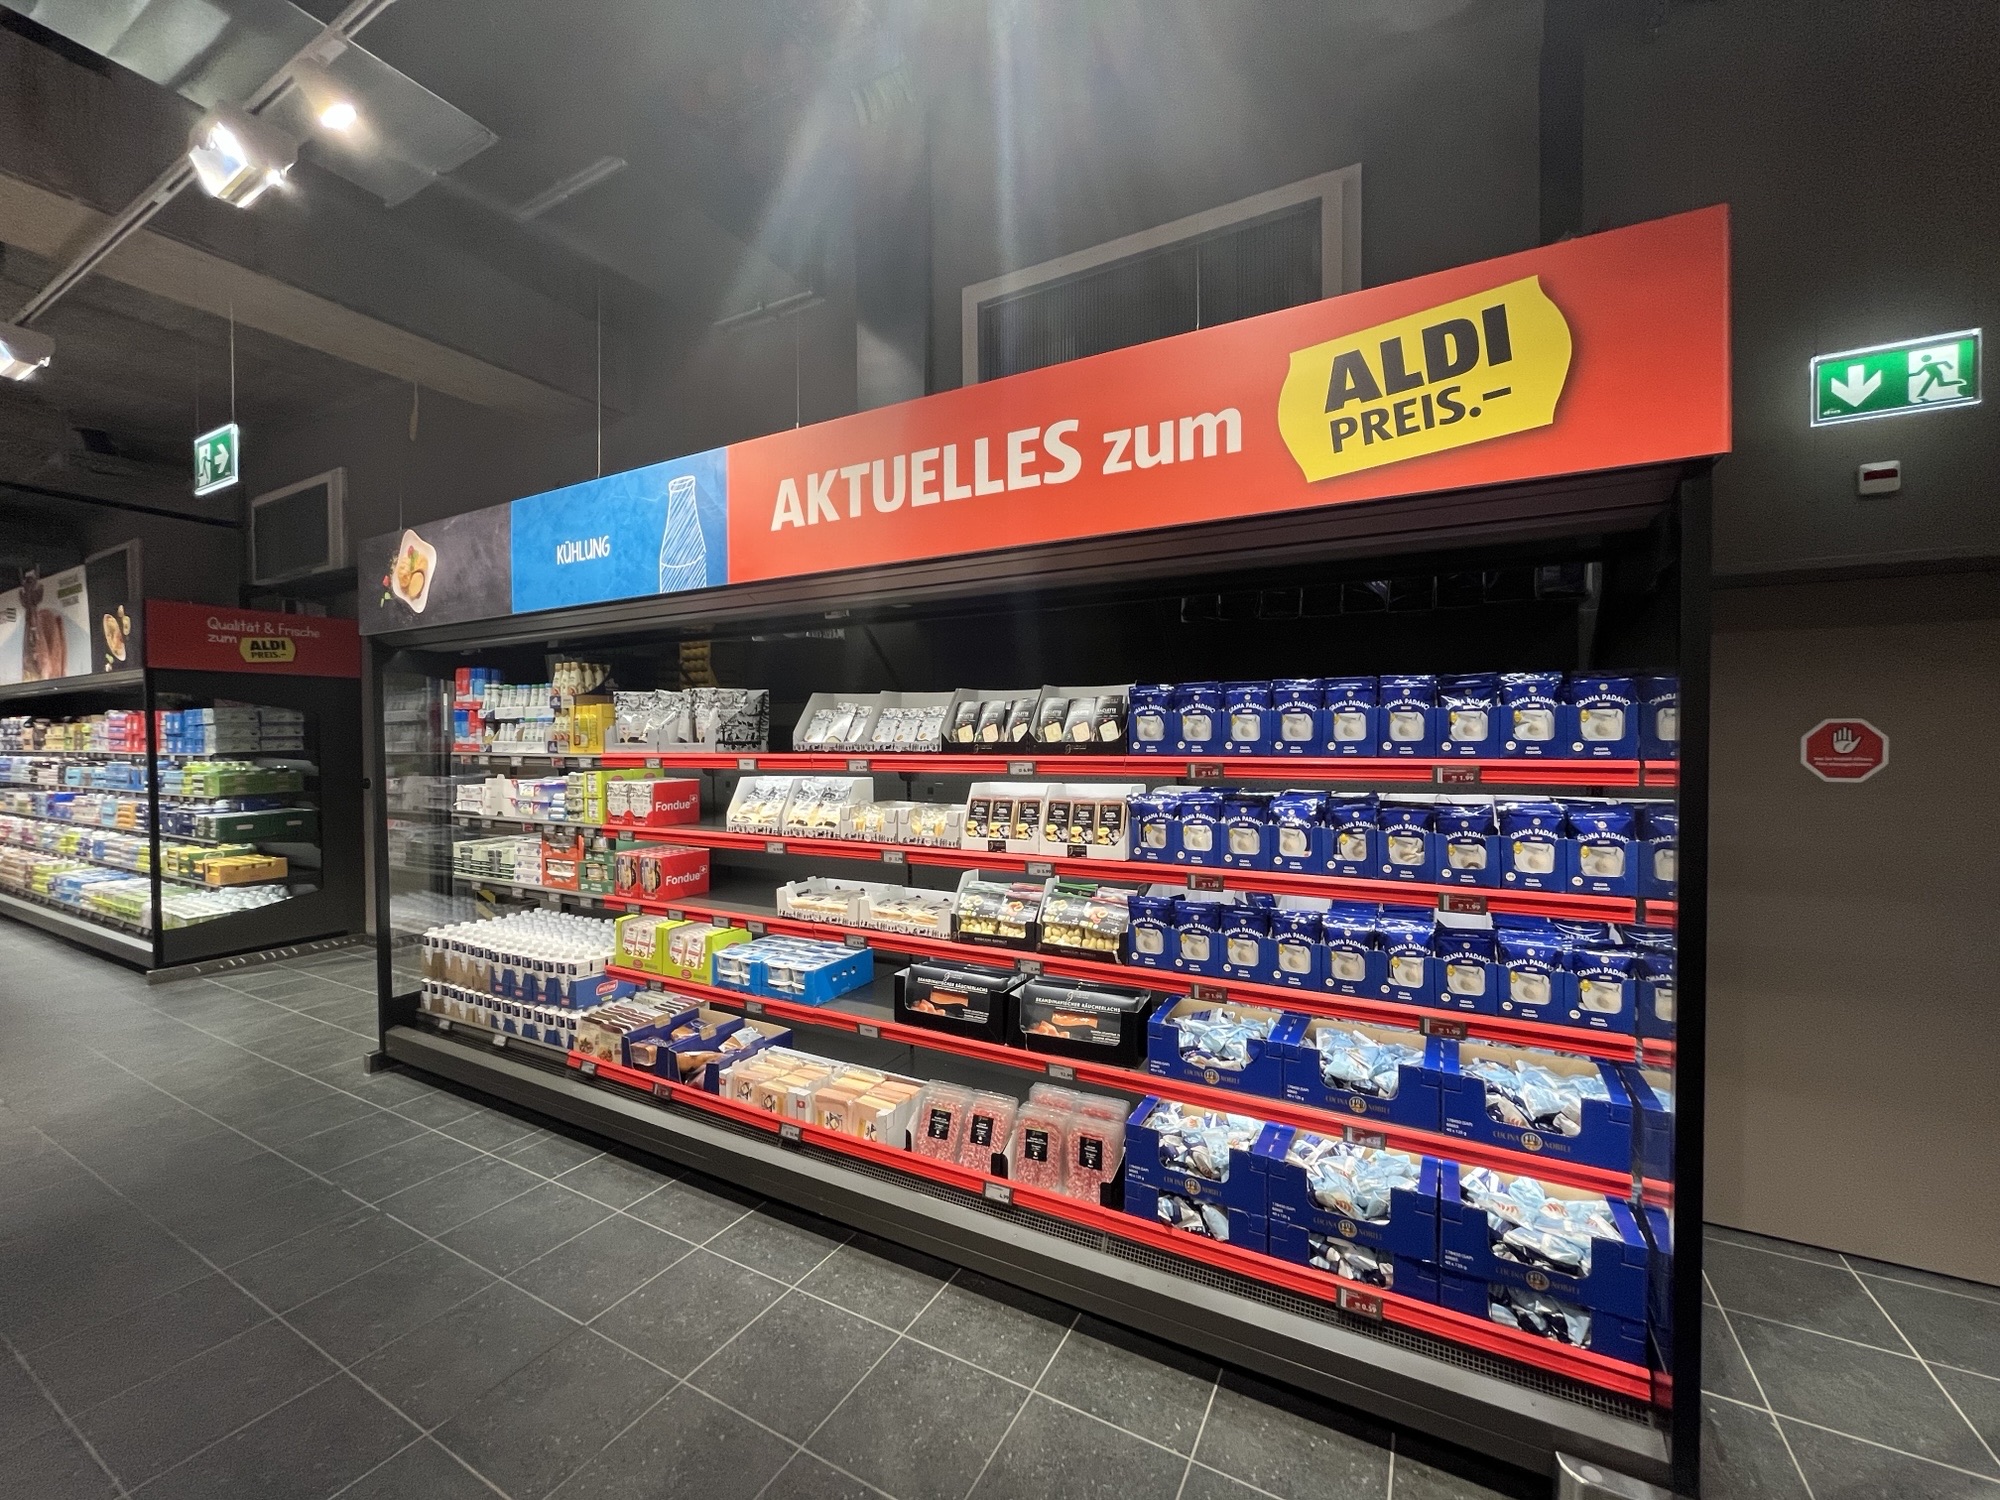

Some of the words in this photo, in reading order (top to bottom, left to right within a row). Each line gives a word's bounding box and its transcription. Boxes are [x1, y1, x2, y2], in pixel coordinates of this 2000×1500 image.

[1324, 303, 1512, 413] ALDI
[770, 419, 1083, 532] AKTUELLES
[1102, 407, 1242, 474] zum
[556, 535, 611, 566] KÜHLUNG
[207, 616, 260, 634] Qualität
[264, 622, 275, 635] &
[278, 623, 321, 639] Frische
[207, 634, 237, 643] zum
[250, 640, 286, 651] ALDI
[1576, 695, 1600, 708] GRANA
[1601, 694, 1631, 706] PADANO
[655, 800, 691, 812] Fondue
[1511, 829, 1532, 840] GRANA
[1601, 831, 1630, 844] PADANO
[665, 872, 701, 887] Fondue
[1506, 958, 1528, 968] GRANA
[1577, 967, 1602, 977] GRANA
[1361, 1302, 1377, 1313] 0.59
